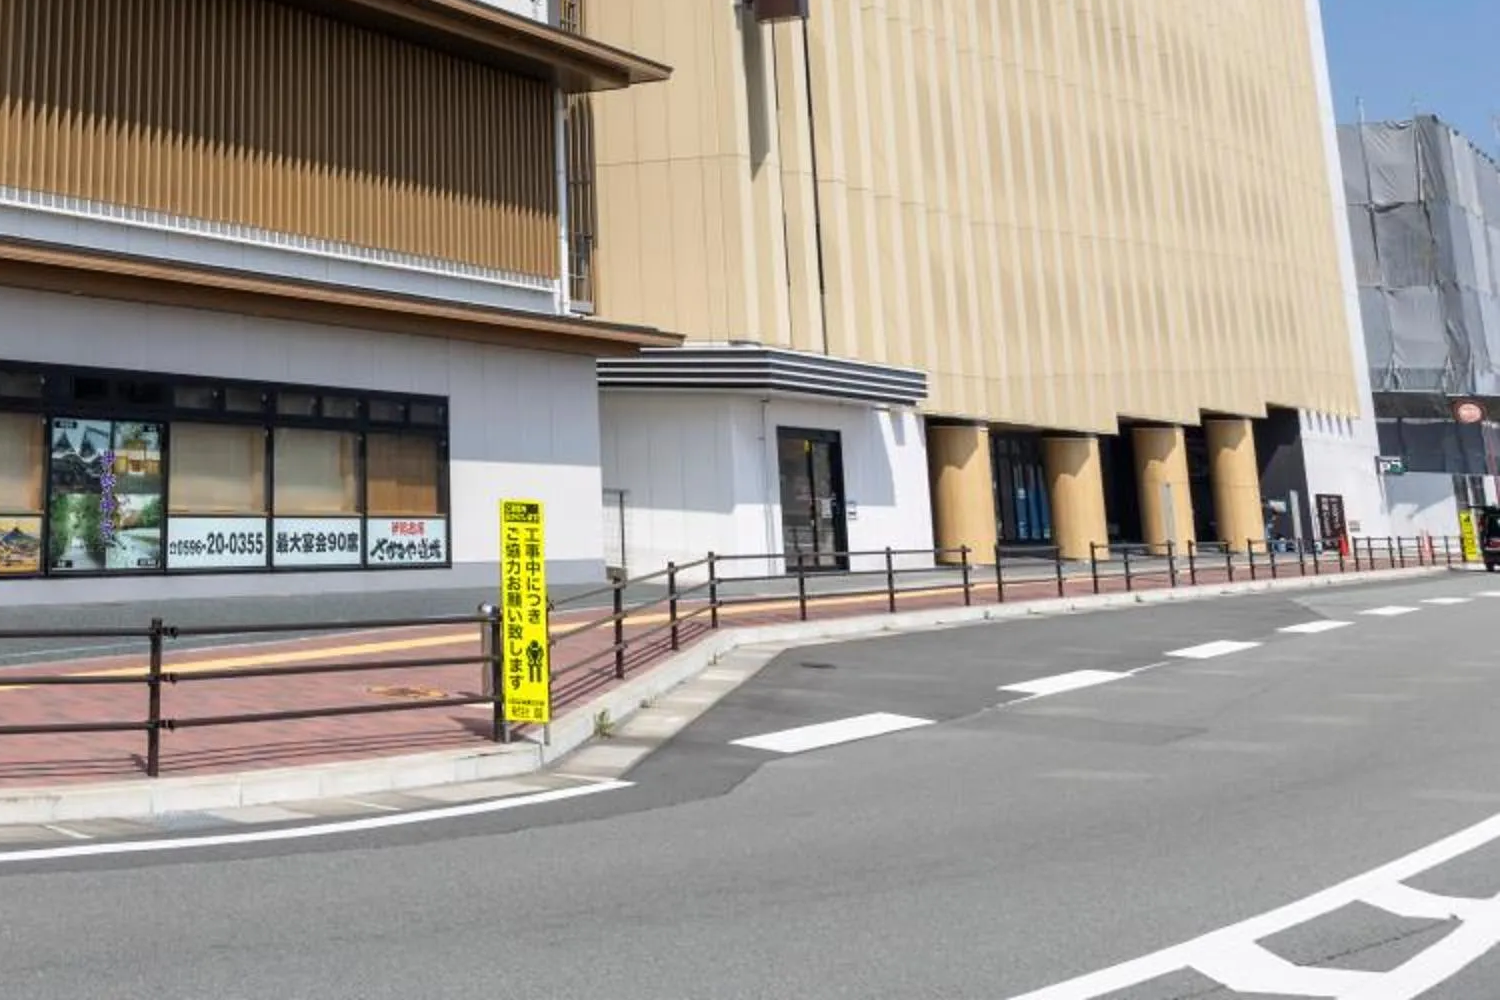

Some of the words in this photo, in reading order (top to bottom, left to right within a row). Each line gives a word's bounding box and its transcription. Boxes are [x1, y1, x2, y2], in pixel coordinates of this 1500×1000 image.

[275, 530, 360, 555] 最大宴会90席
[524, 526, 541, 625] 工事中につき
[505, 527, 524, 691] ご協力お願い致します
